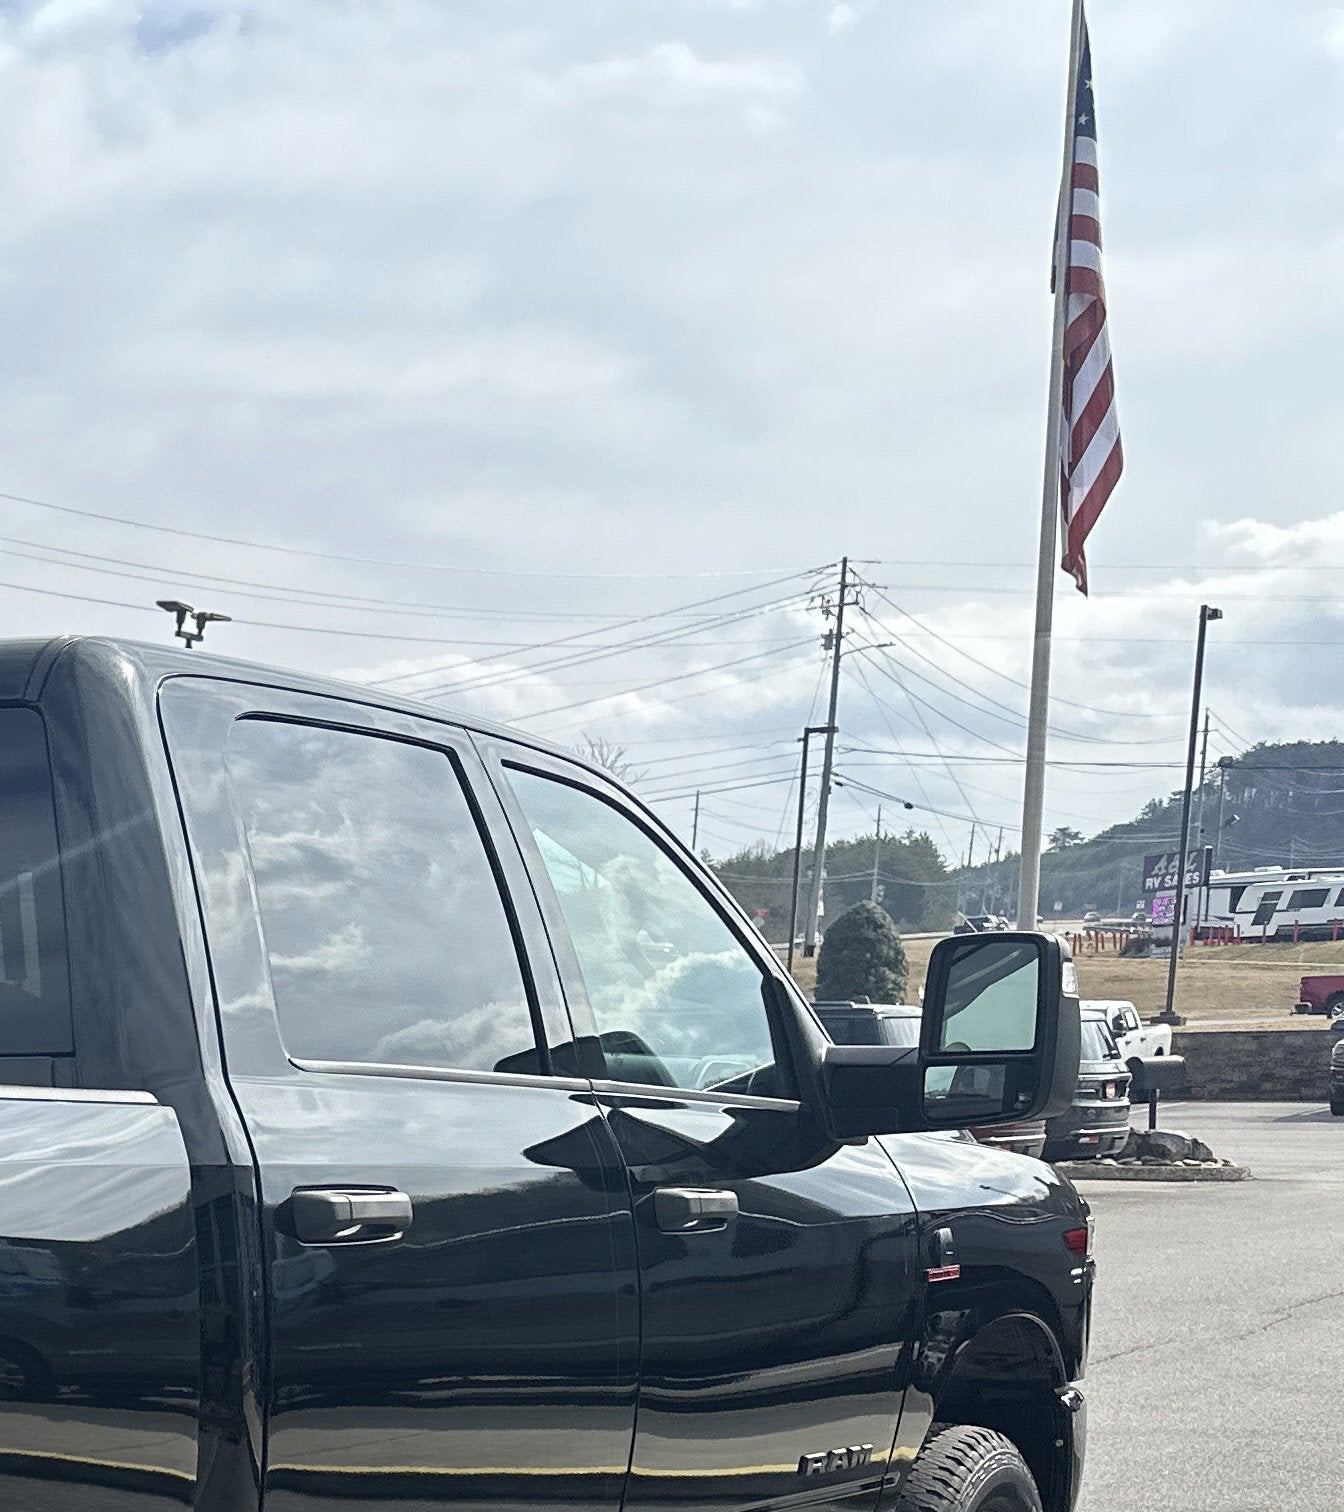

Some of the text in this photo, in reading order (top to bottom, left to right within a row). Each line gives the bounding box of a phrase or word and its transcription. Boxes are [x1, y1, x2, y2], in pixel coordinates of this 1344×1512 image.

[1145, 871, 1200, 890] RV SAES
[797, 1443, 874, 1477] RAM
